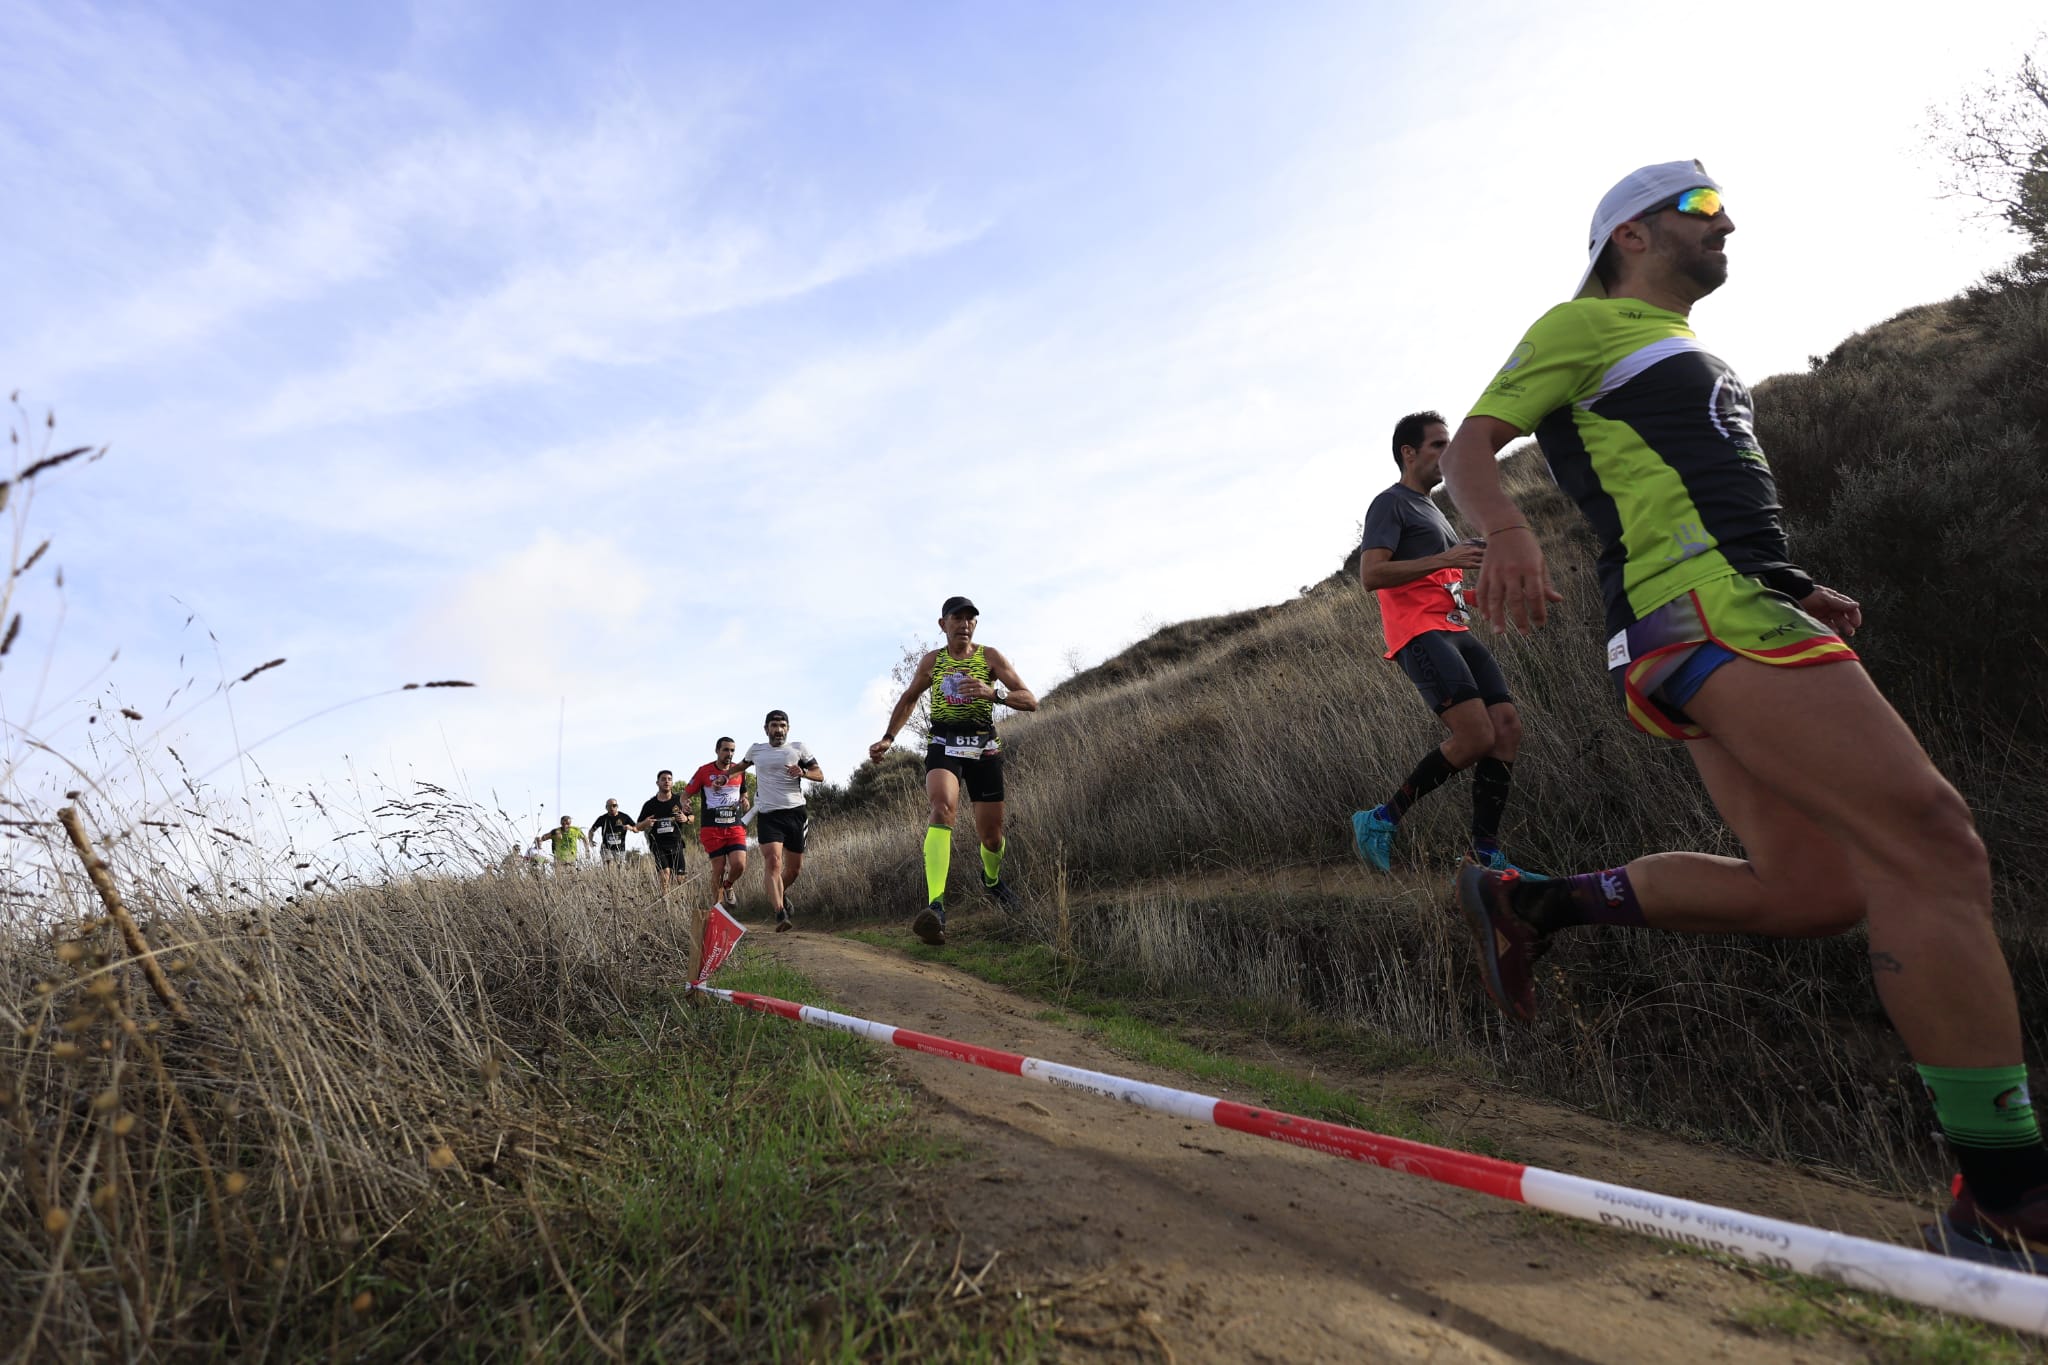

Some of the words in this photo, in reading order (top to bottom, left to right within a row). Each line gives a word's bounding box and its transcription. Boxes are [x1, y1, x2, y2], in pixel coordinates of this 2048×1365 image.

[1048, 1076, 1099, 1096] Salamanca
[1269, 1131, 1352, 1161] Salamanca
[1594, 1191, 1664, 1220] Deportes
[1669, 1207, 1690, 1224] de
